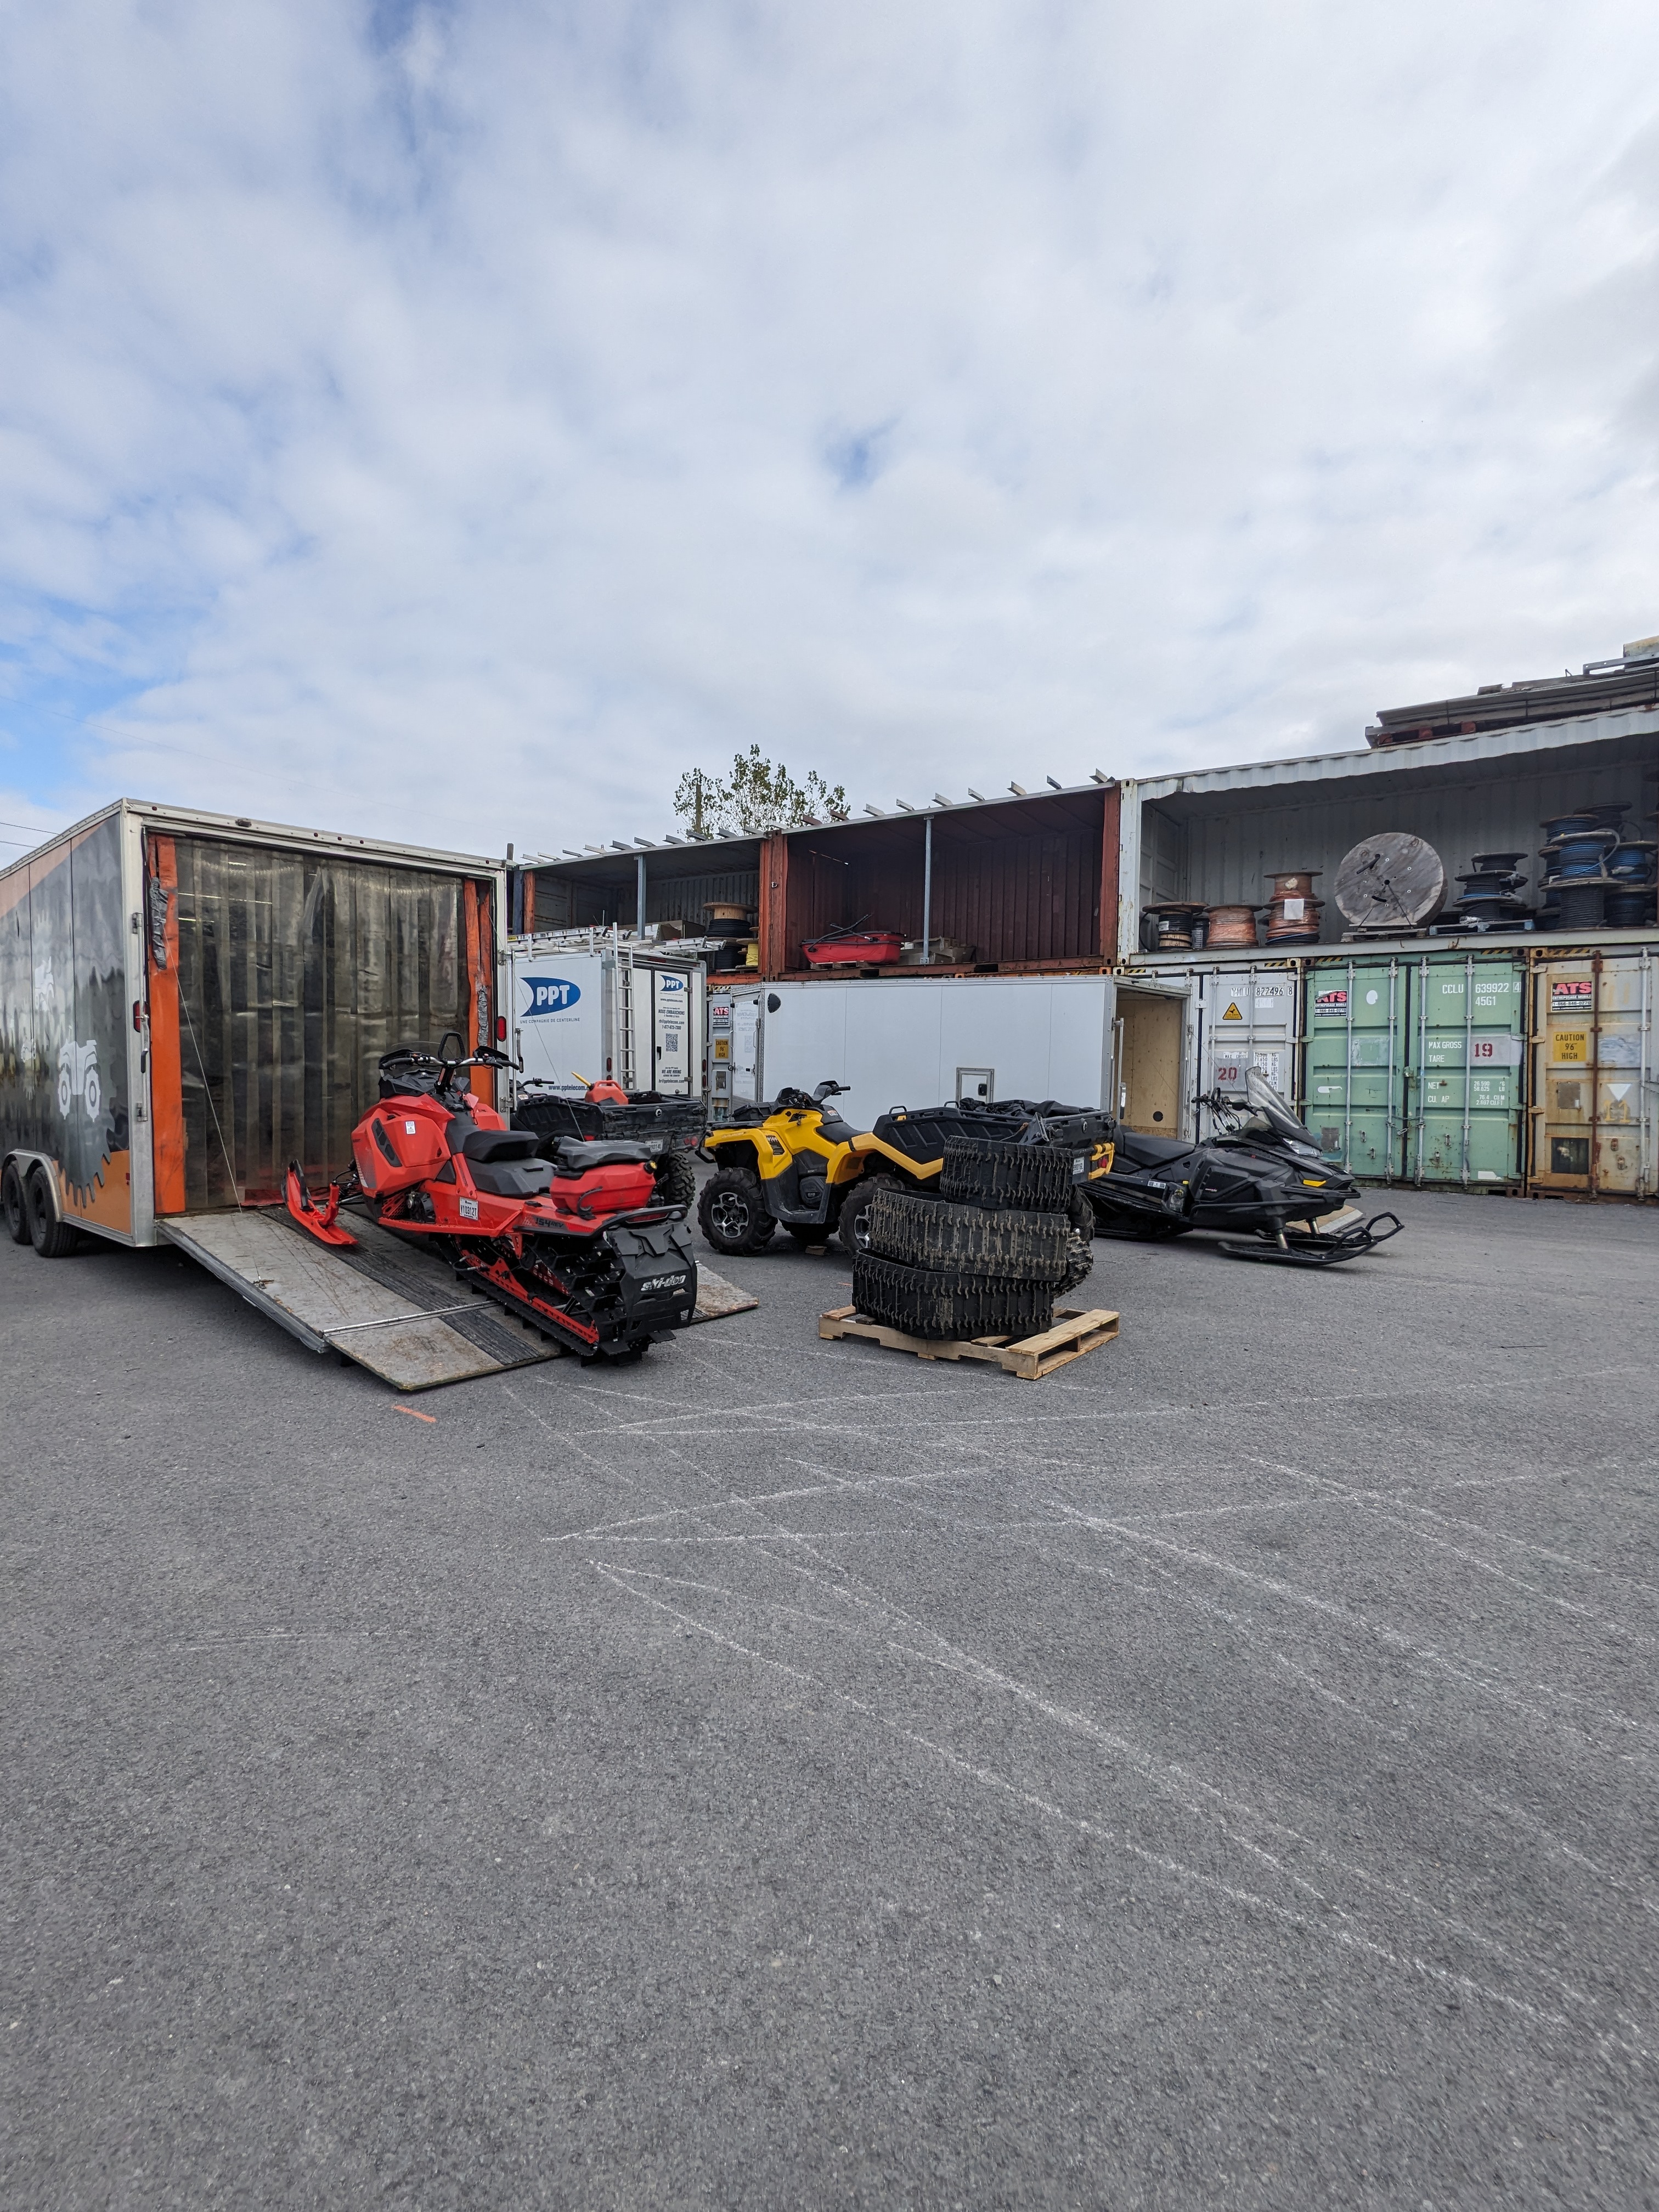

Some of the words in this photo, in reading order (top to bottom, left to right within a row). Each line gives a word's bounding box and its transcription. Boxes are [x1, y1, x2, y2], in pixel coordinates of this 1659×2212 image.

[666, 979, 680, 989] PPT
[1442, 984, 1464, 994] CCLU
[1475, 983, 1509, 993] 639922
[1554, 982, 1592, 995] ATS
[537, 985, 570, 1006] PPT
[1288, 986, 1293, 995] 8
[1475, 996, 1496, 1006] 45G1
[1475, 1043, 1493, 1057] 19
[1218, 1067, 1237, 1081] 20
[461, 1205, 477, 1216] V10312T
